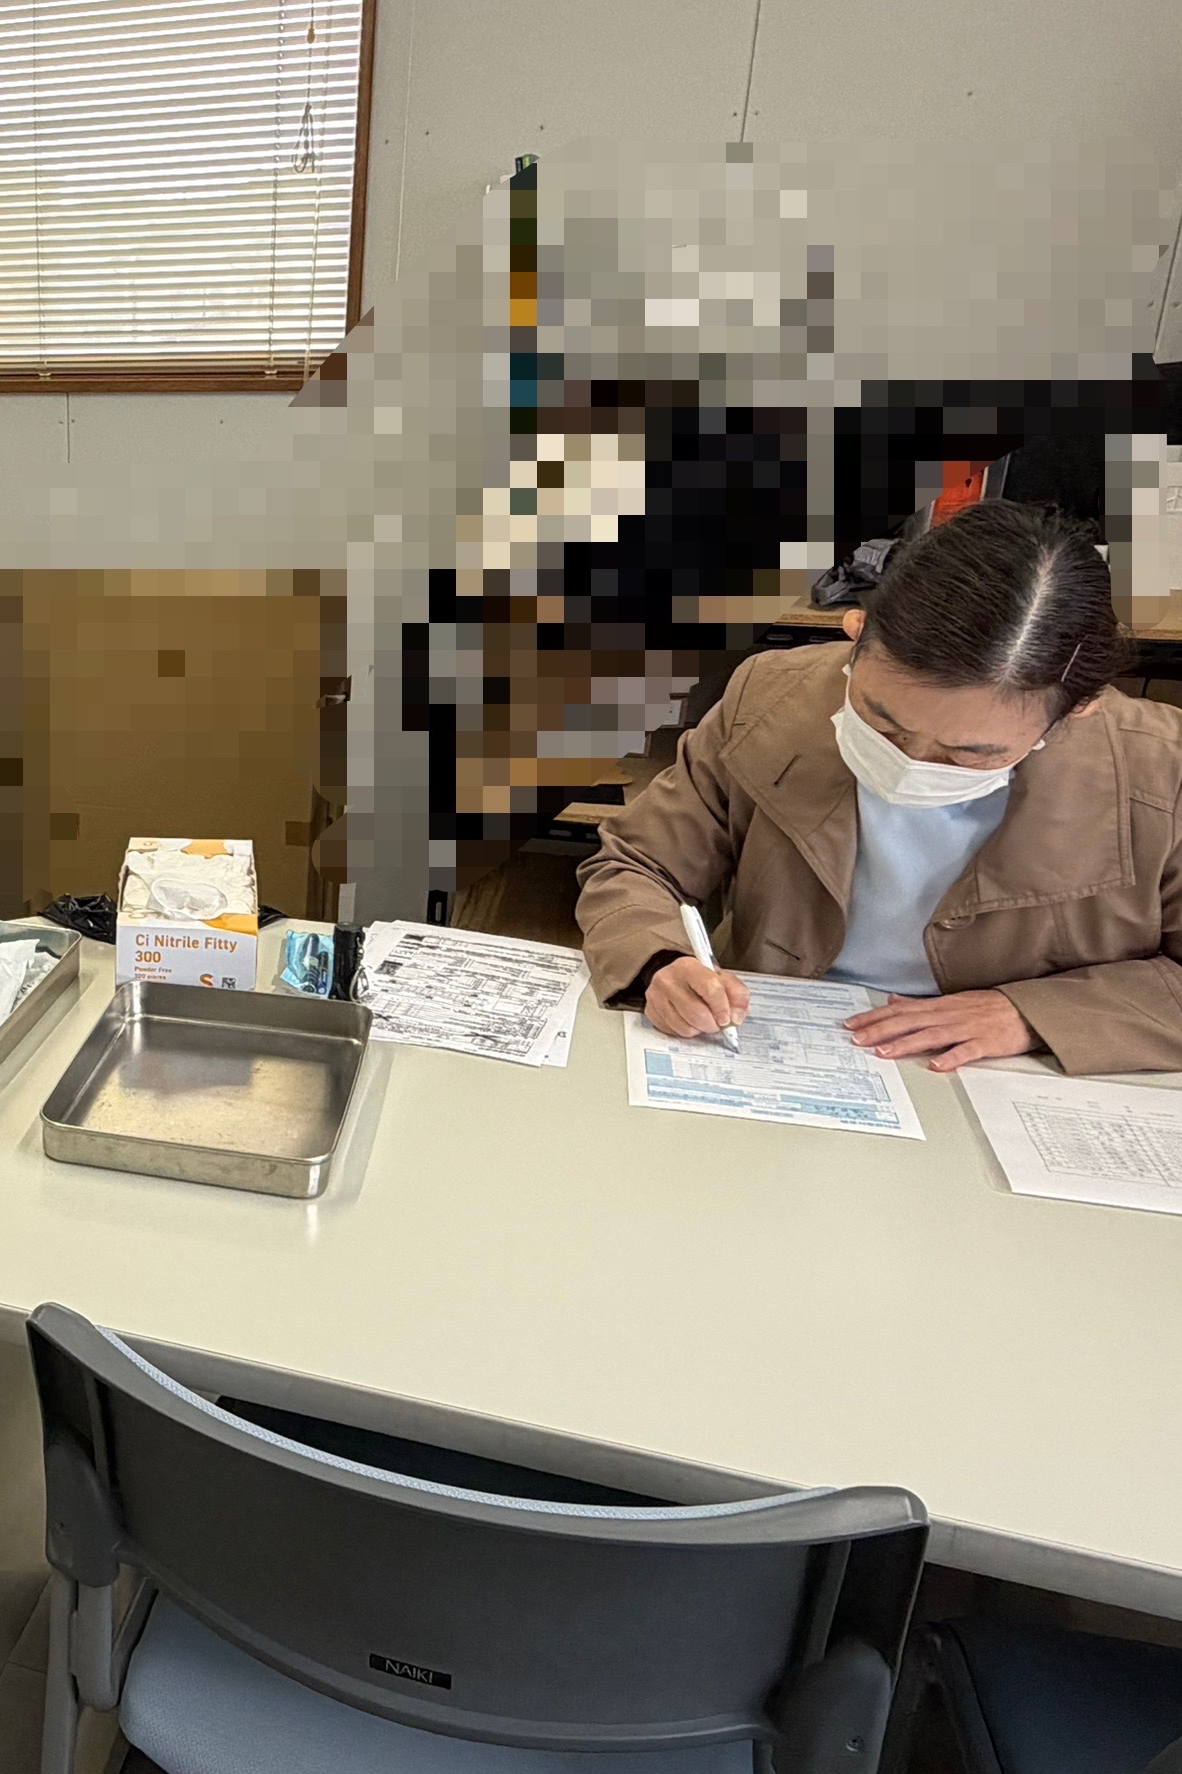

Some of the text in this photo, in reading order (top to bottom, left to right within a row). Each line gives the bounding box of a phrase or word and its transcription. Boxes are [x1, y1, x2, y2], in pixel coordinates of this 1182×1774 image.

[135, 934, 237, 953] Ci Nitrile Fitty
[135, 950, 161, 963] 300
[386, 1659, 432, 1683] NAIKI
